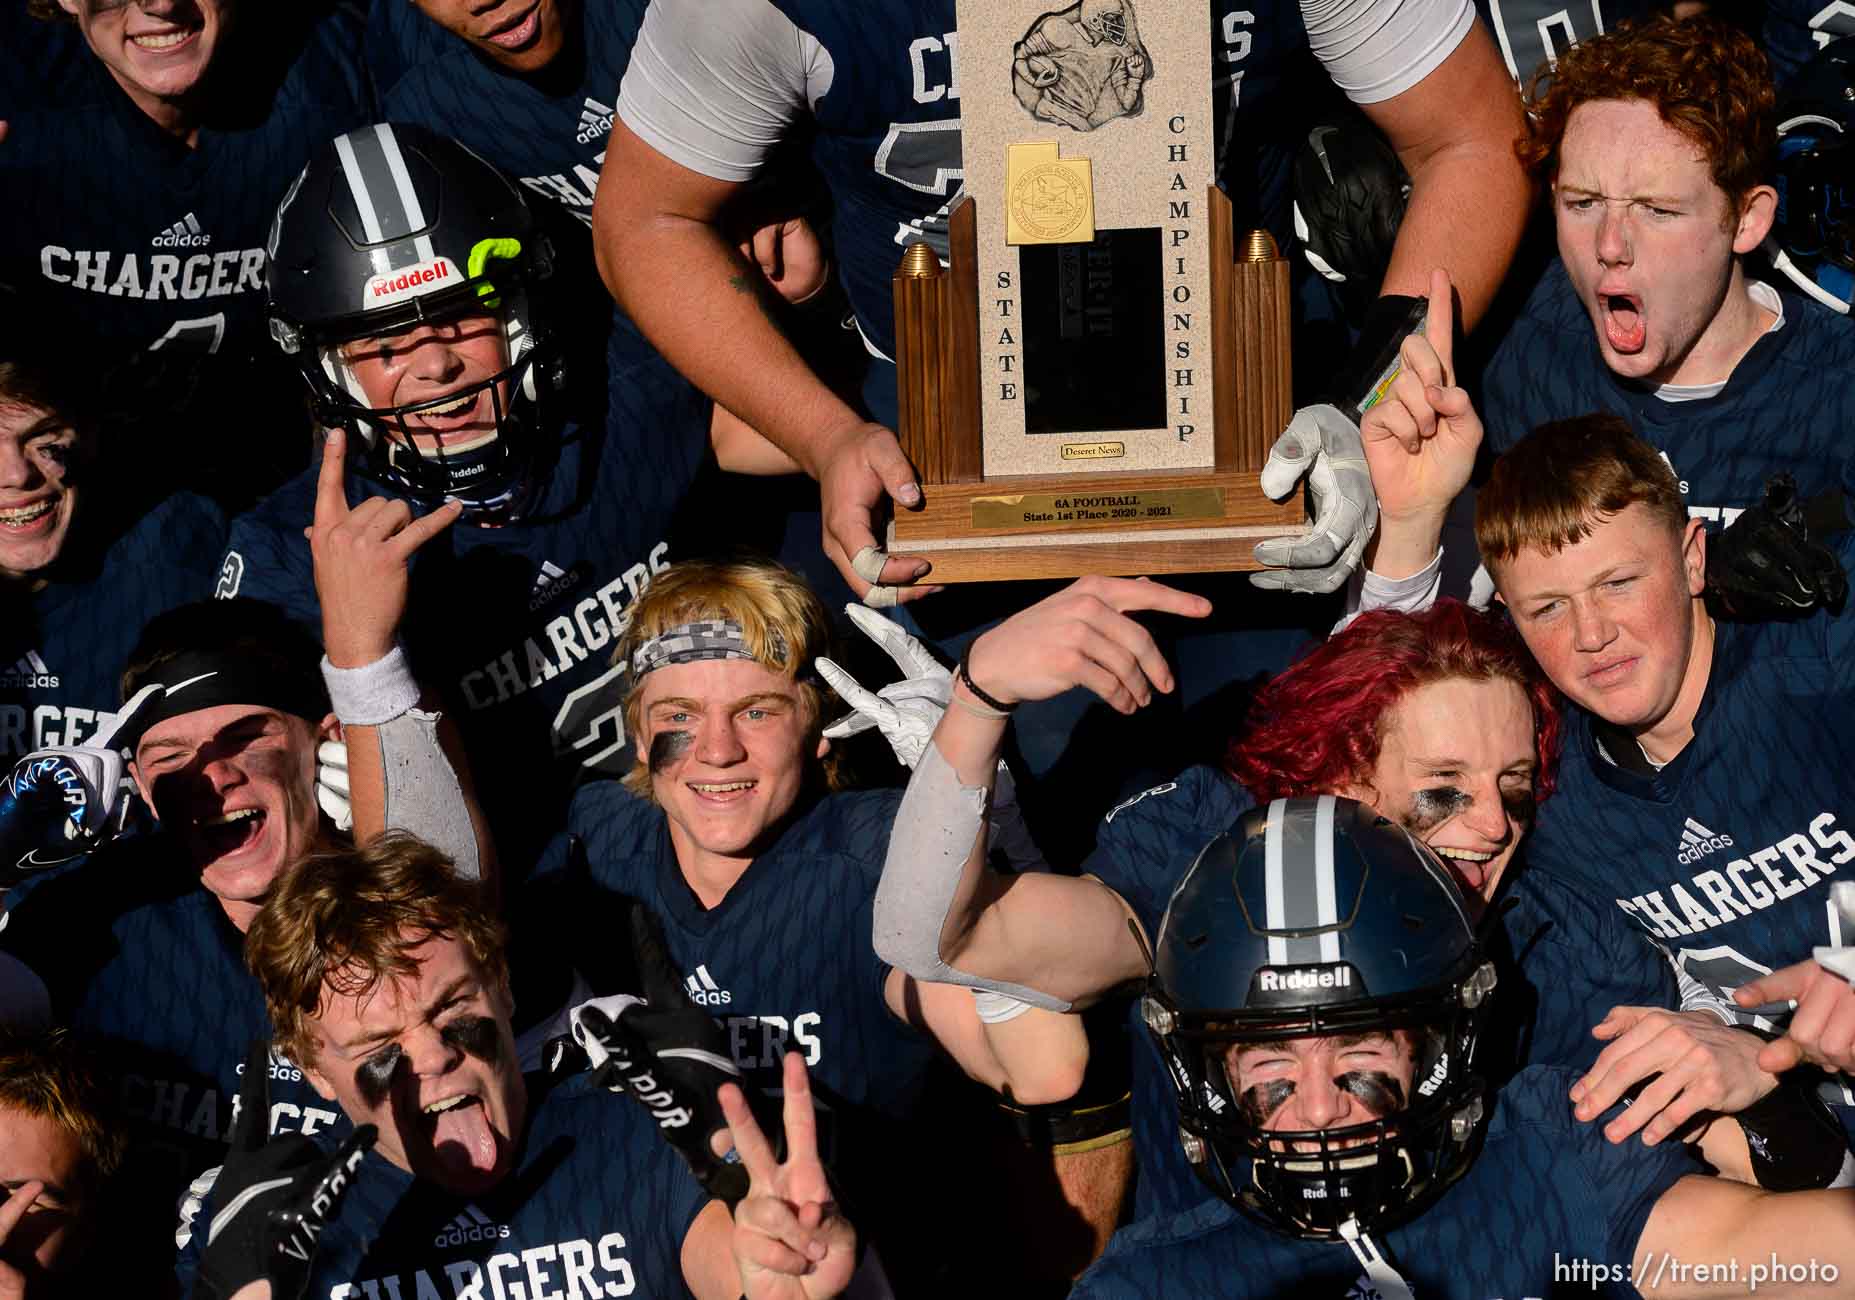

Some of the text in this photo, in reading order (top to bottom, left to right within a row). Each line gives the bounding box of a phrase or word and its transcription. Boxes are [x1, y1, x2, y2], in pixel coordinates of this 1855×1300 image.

[152, 228, 212, 248] adidas
[41, 244, 270, 301] CHARGER
[371, 261, 449, 296] Riddell
[1167, 116, 1195, 442] CHAMPIONSHIP
[996, 271, 1017, 400] STATE
[1065, 445, 1121, 456] Deseret News
[1023, 511, 1054, 522] State
[1057, 510, 1073, 520] 1st
[1077, 509, 1108, 519] Place
[1111, 507, 1137, 518] 2020
[1146, 506, 1172, 516] 2021
[1055, 496, 1141, 508] 6A FOOTBALL
[529, 569, 580, 612] adidas
[1677, 833, 1734, 865] adidas
[1260, 966, 1351, 992] Riddell
[722, 1012, 822, 1068] ERS
[433, 1224, 511, 1248] adidas
